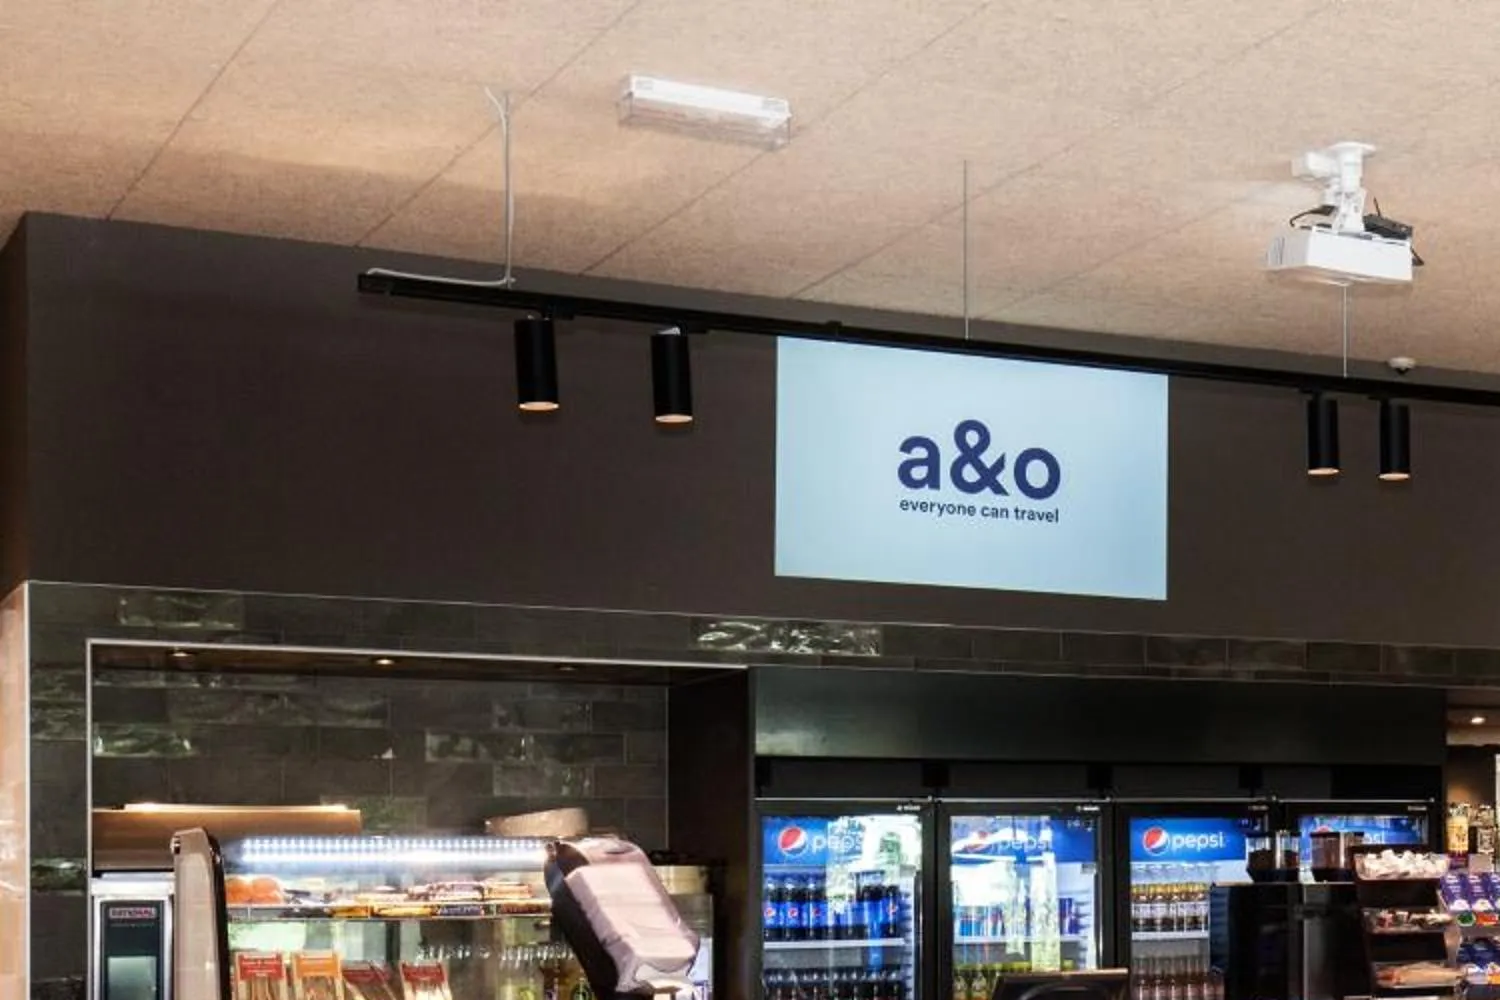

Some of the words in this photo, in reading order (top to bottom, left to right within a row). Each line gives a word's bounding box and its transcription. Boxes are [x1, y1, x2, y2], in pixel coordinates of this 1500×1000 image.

[897, 419, 1061, 500] a&o
[900, 499, 977, 517] everyone
[980, 506, 1010, 519] can
[1014, 506, 1059, 523] travel
[811, 833, 866, 854] peps
[1171, 831, 1225, 853] pepsi
